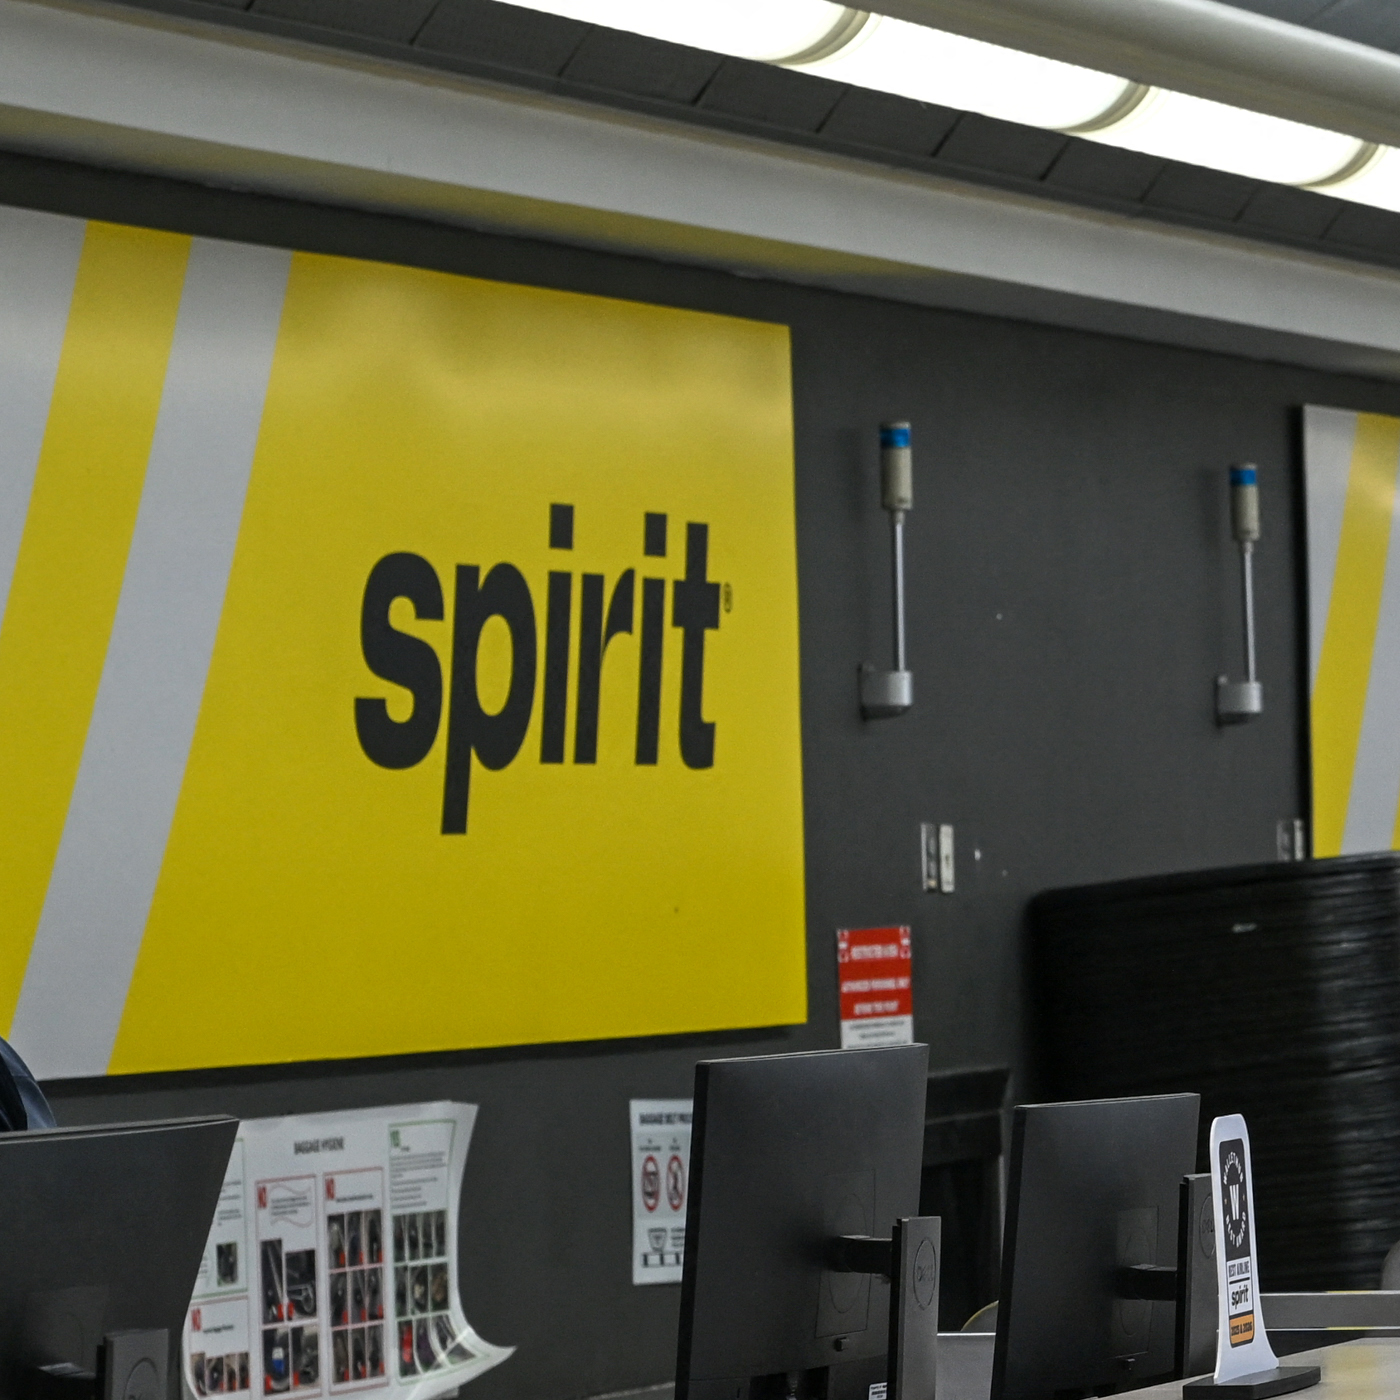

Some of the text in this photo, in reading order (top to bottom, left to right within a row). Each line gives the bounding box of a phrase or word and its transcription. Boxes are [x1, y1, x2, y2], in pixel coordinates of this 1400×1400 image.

[354, 502, 721, 835] spirit
[1229, 1183, 1239, 1221] W
[1231, 1284, 1249, 1310] spirit
